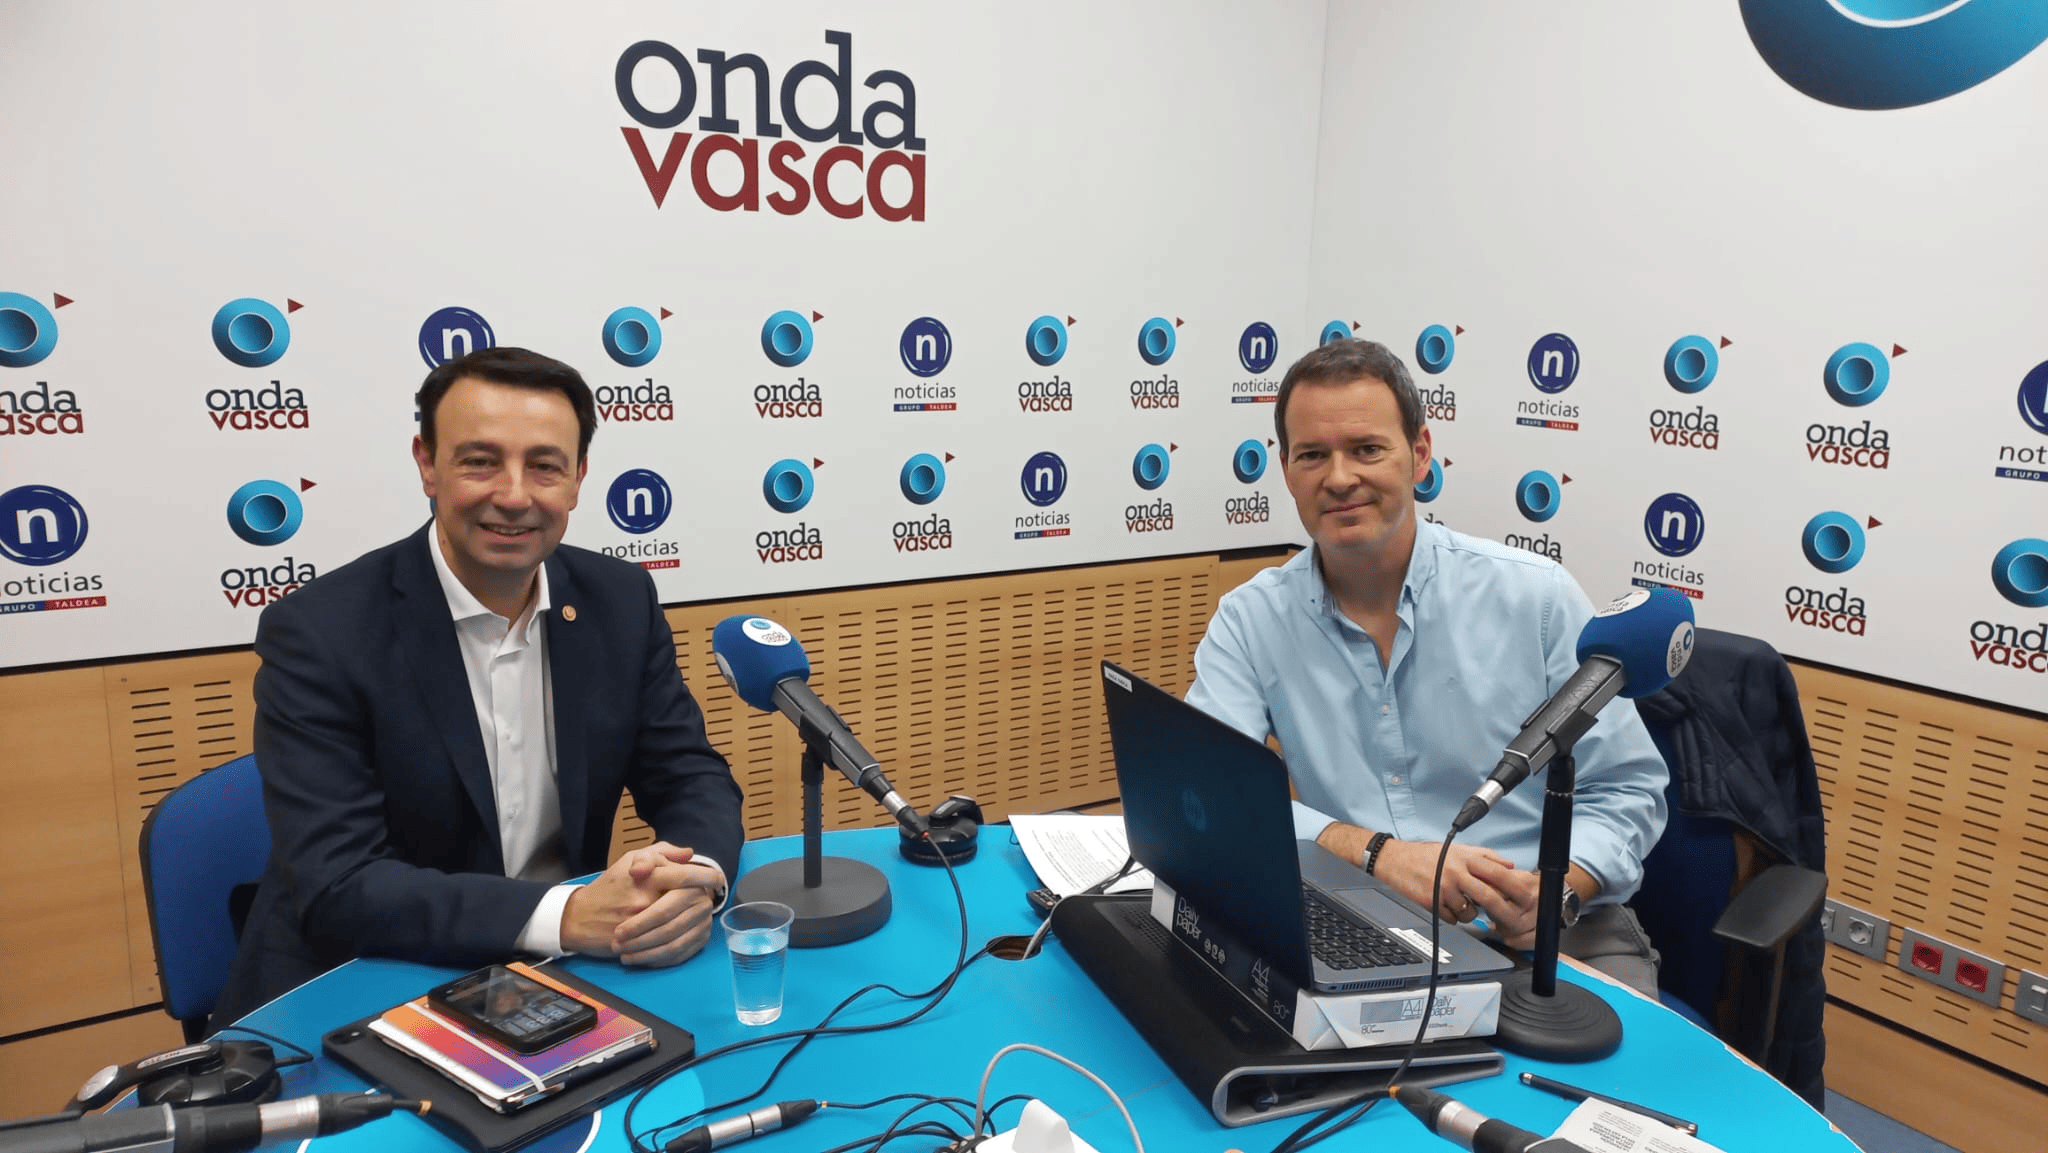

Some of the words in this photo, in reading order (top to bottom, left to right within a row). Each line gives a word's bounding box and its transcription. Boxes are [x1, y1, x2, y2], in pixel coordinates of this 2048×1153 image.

[615, 29, 926, 151] onda
[620, 126, 926, 222] vasca
[442, 327, 473, 360] n
[916, 334, 937, 361] n
[1250, 336, 1267, 360] n
[1541, 350, 1564, 377] n
[205, 380, 308, 411] onda
[595, 378, 673, 405] onda
[754, 377, 822, 402] onda
[894, 382, 956, 399] noticias
[1018, 376, 1072, 398] onda
[1130, 374, 1179, 395] onda
[1232, 378, 1280, 392] noticias
[1418, 384, 1456, 407] nda
[0, 381, 81, 413] nda
[1019, 397, 1073, 413] vasca
[1131, 394, 1179, 409] vasca
[1518, 399, 1579, 418] noticias
[208, 409, 309, 431] vasca
[597, 403, 674, 422] vasca
[755, 401, 822, 419] vasca
[1424, 405, 1456, 422] sca
[1650, 405, 1719, 433] onda
[0, 413, 84, 435] asca
[1806, 420, 1890, 450] onda
[1650, 427, 1719, 450] vasca
[1806, 443, 1889, 469] vasca
[1035, 467, 1054, 492] n
[2005, 469, 2040, 480] GRUPO
[626, 487, 653, 516] n
[1125, 498, 1173, 520] onda
[1225, 491, 1269, 512] onda
[16, 507, 59, 544] n
[893, 513, 952, 538] onda
[1016, 511, 1070, 528] noticias
[1125, 515, 1174, 534] vasca
[1225, 508, 1269, 526] vasca
[1661, 510, 1687, 541] n
[756, 522, 823, 549] onda
[893, 534, 952, 553] vasca
[1505, 533, 1562, 559] onda
[602, 539, 679, 559] noticias
[757, 544, 823, 564] vasca
[0, 571, 103, 597] oticias
[221, 556, 316, 590] onda
[1633, 560, 1705, 586] noticias
[55, 599, 98, 608] TALDEA
[1785, 586, 1867, 619] onda
[1785, 603, 1866, 637] vasca
[1970, 620, 2048, 654] ond
[1970, 639, 2048, 673] vasc
[1402, 999, 1422, 1016] A4
